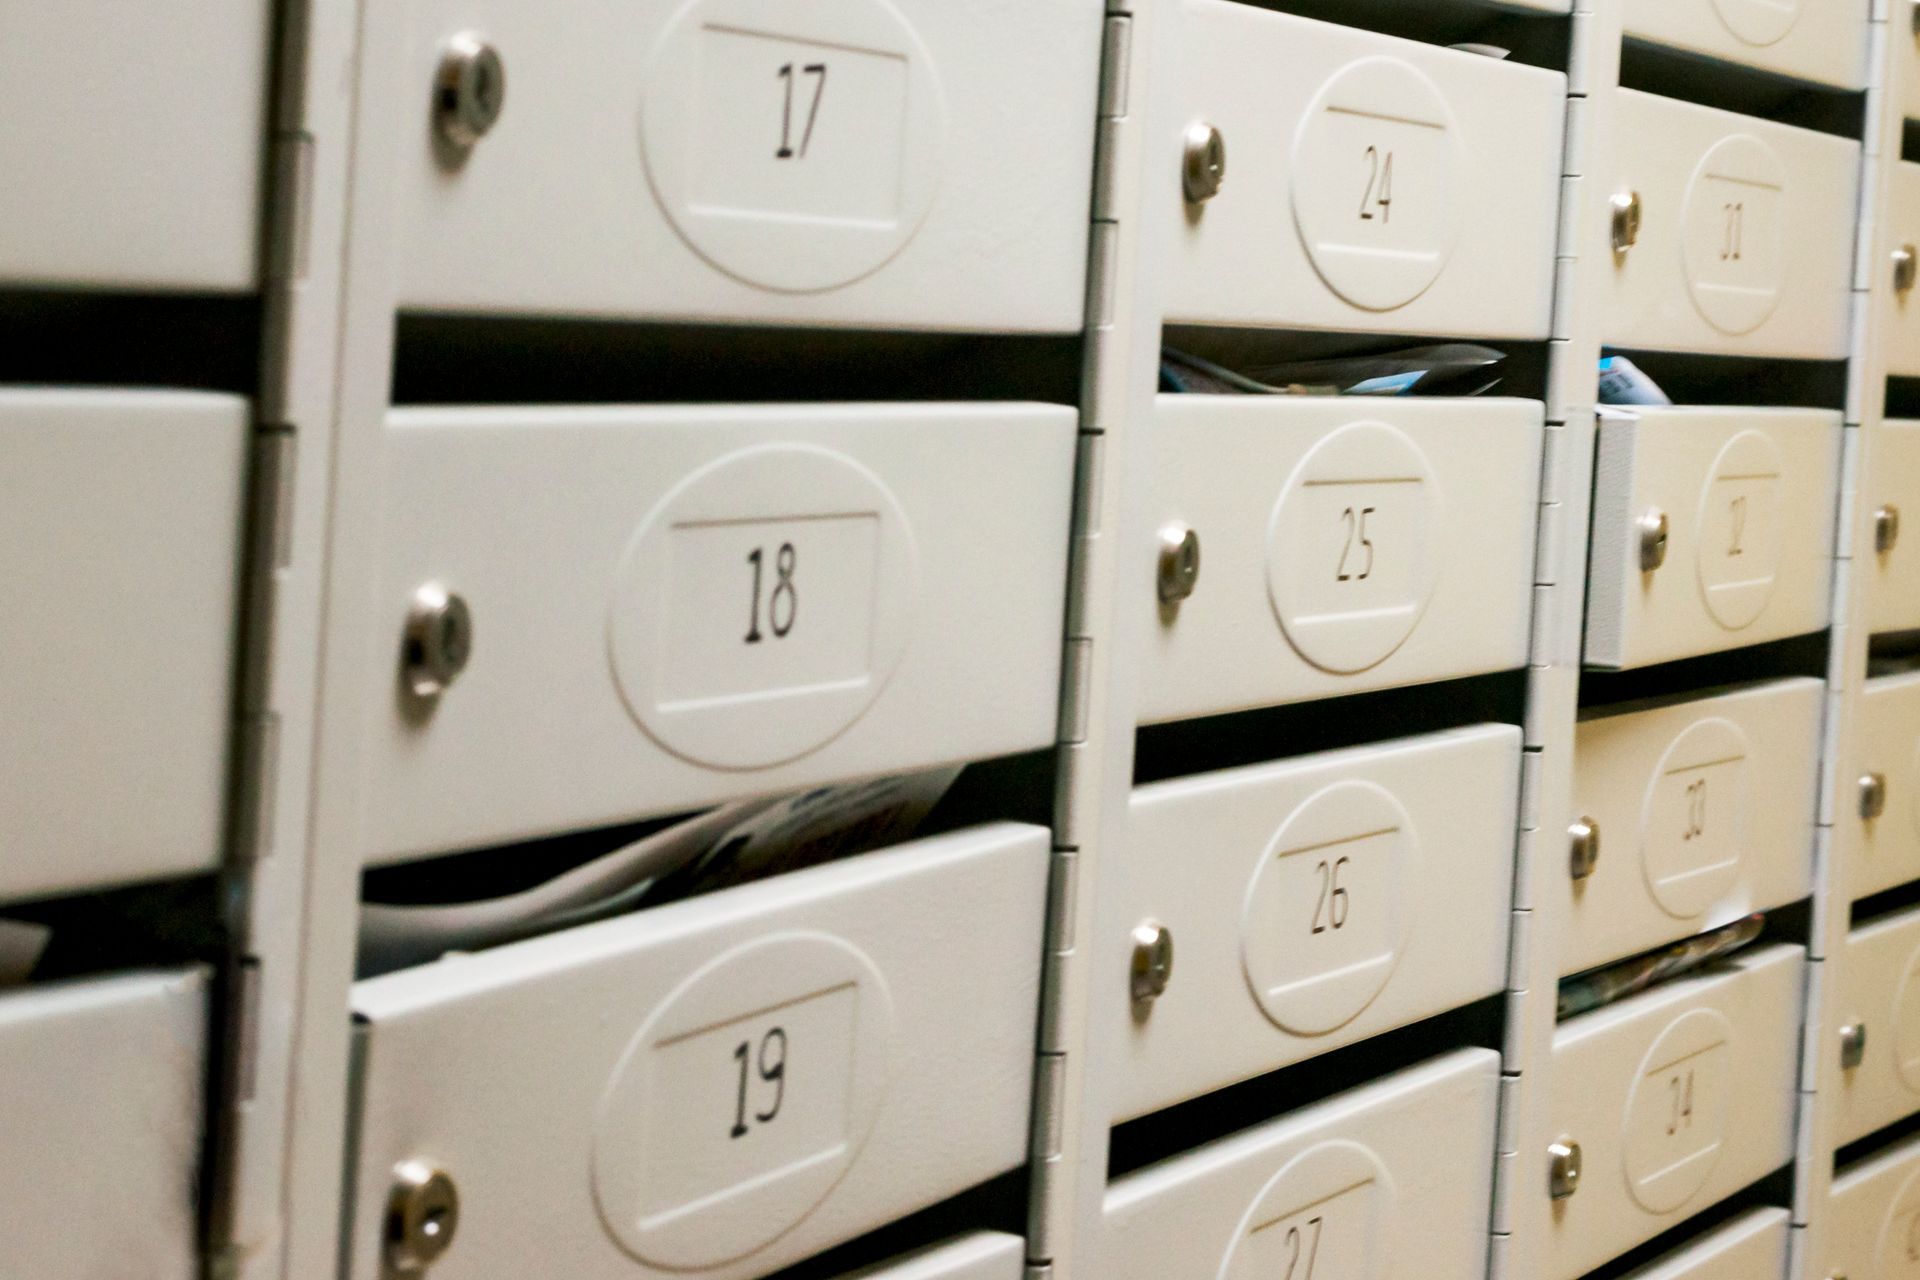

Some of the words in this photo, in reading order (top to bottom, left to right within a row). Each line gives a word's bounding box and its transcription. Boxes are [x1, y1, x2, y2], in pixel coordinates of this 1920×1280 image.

[776, 64, 827, 160] 17
[1360, 146, 1393, 224] 24
[1337, 507, 1374, 581] 25
[744, 543, 795, 644] 18
[1311, 855, 1349, 934] 26
[730, 1027, 786, 1139] 19
[1284, 1217, 1323, 1280] 27
